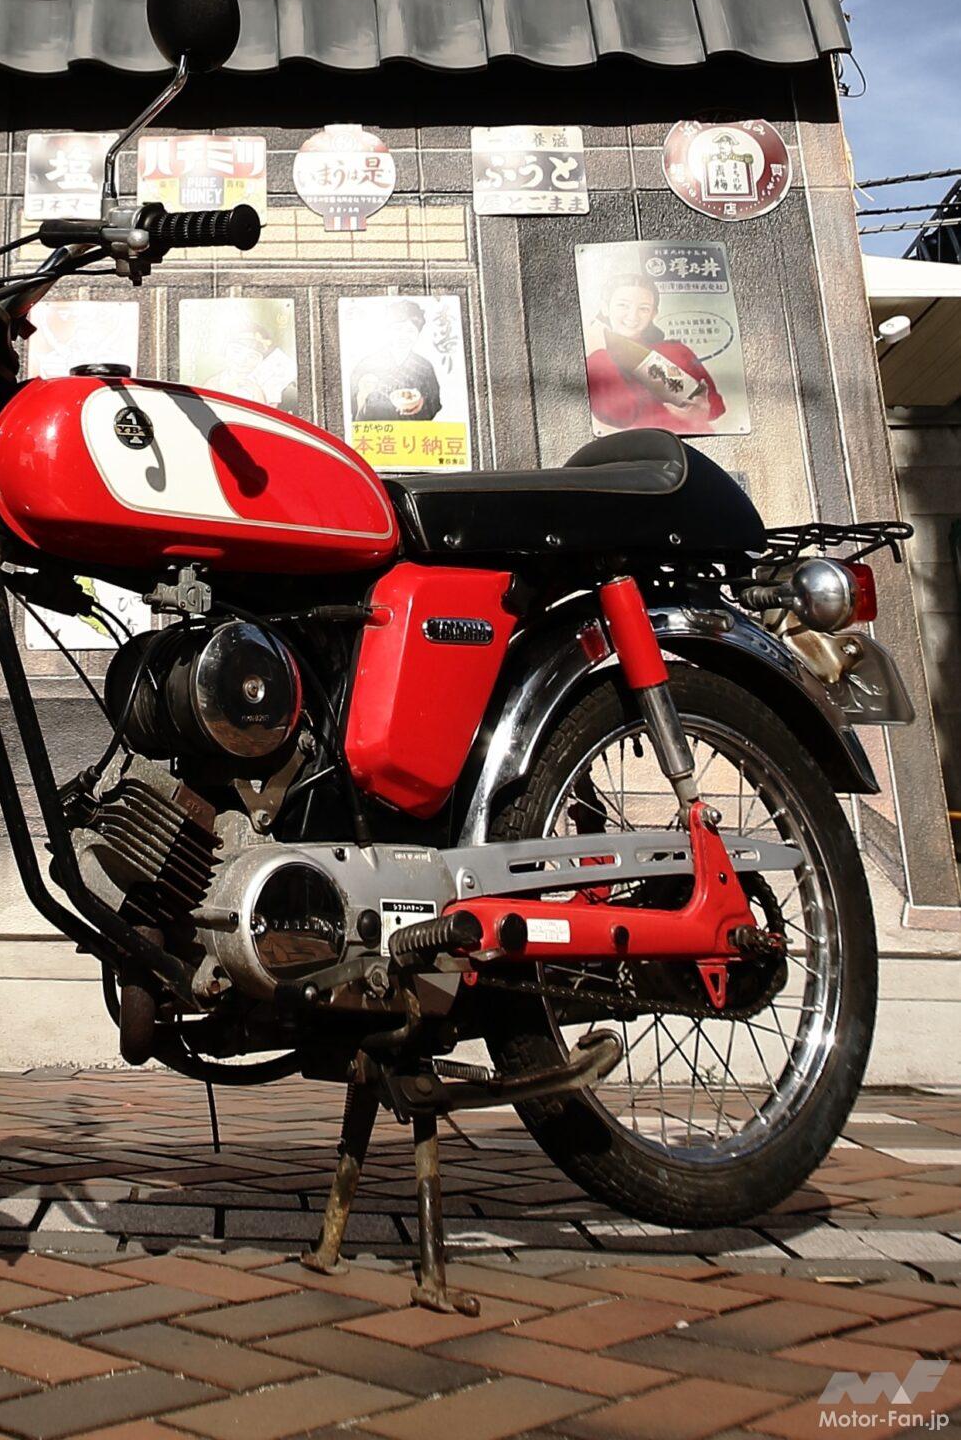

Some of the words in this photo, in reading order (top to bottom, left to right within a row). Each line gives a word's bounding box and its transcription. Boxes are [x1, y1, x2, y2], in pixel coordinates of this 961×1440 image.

[45, 144, 99, 191] 塩
[187, 176, 217, 188] PURE
[30, 197, 97, 212] ヨネマー
[181, 188, 224, 205] HONEY
[354, 435, 467, 456] 本造り納豆
